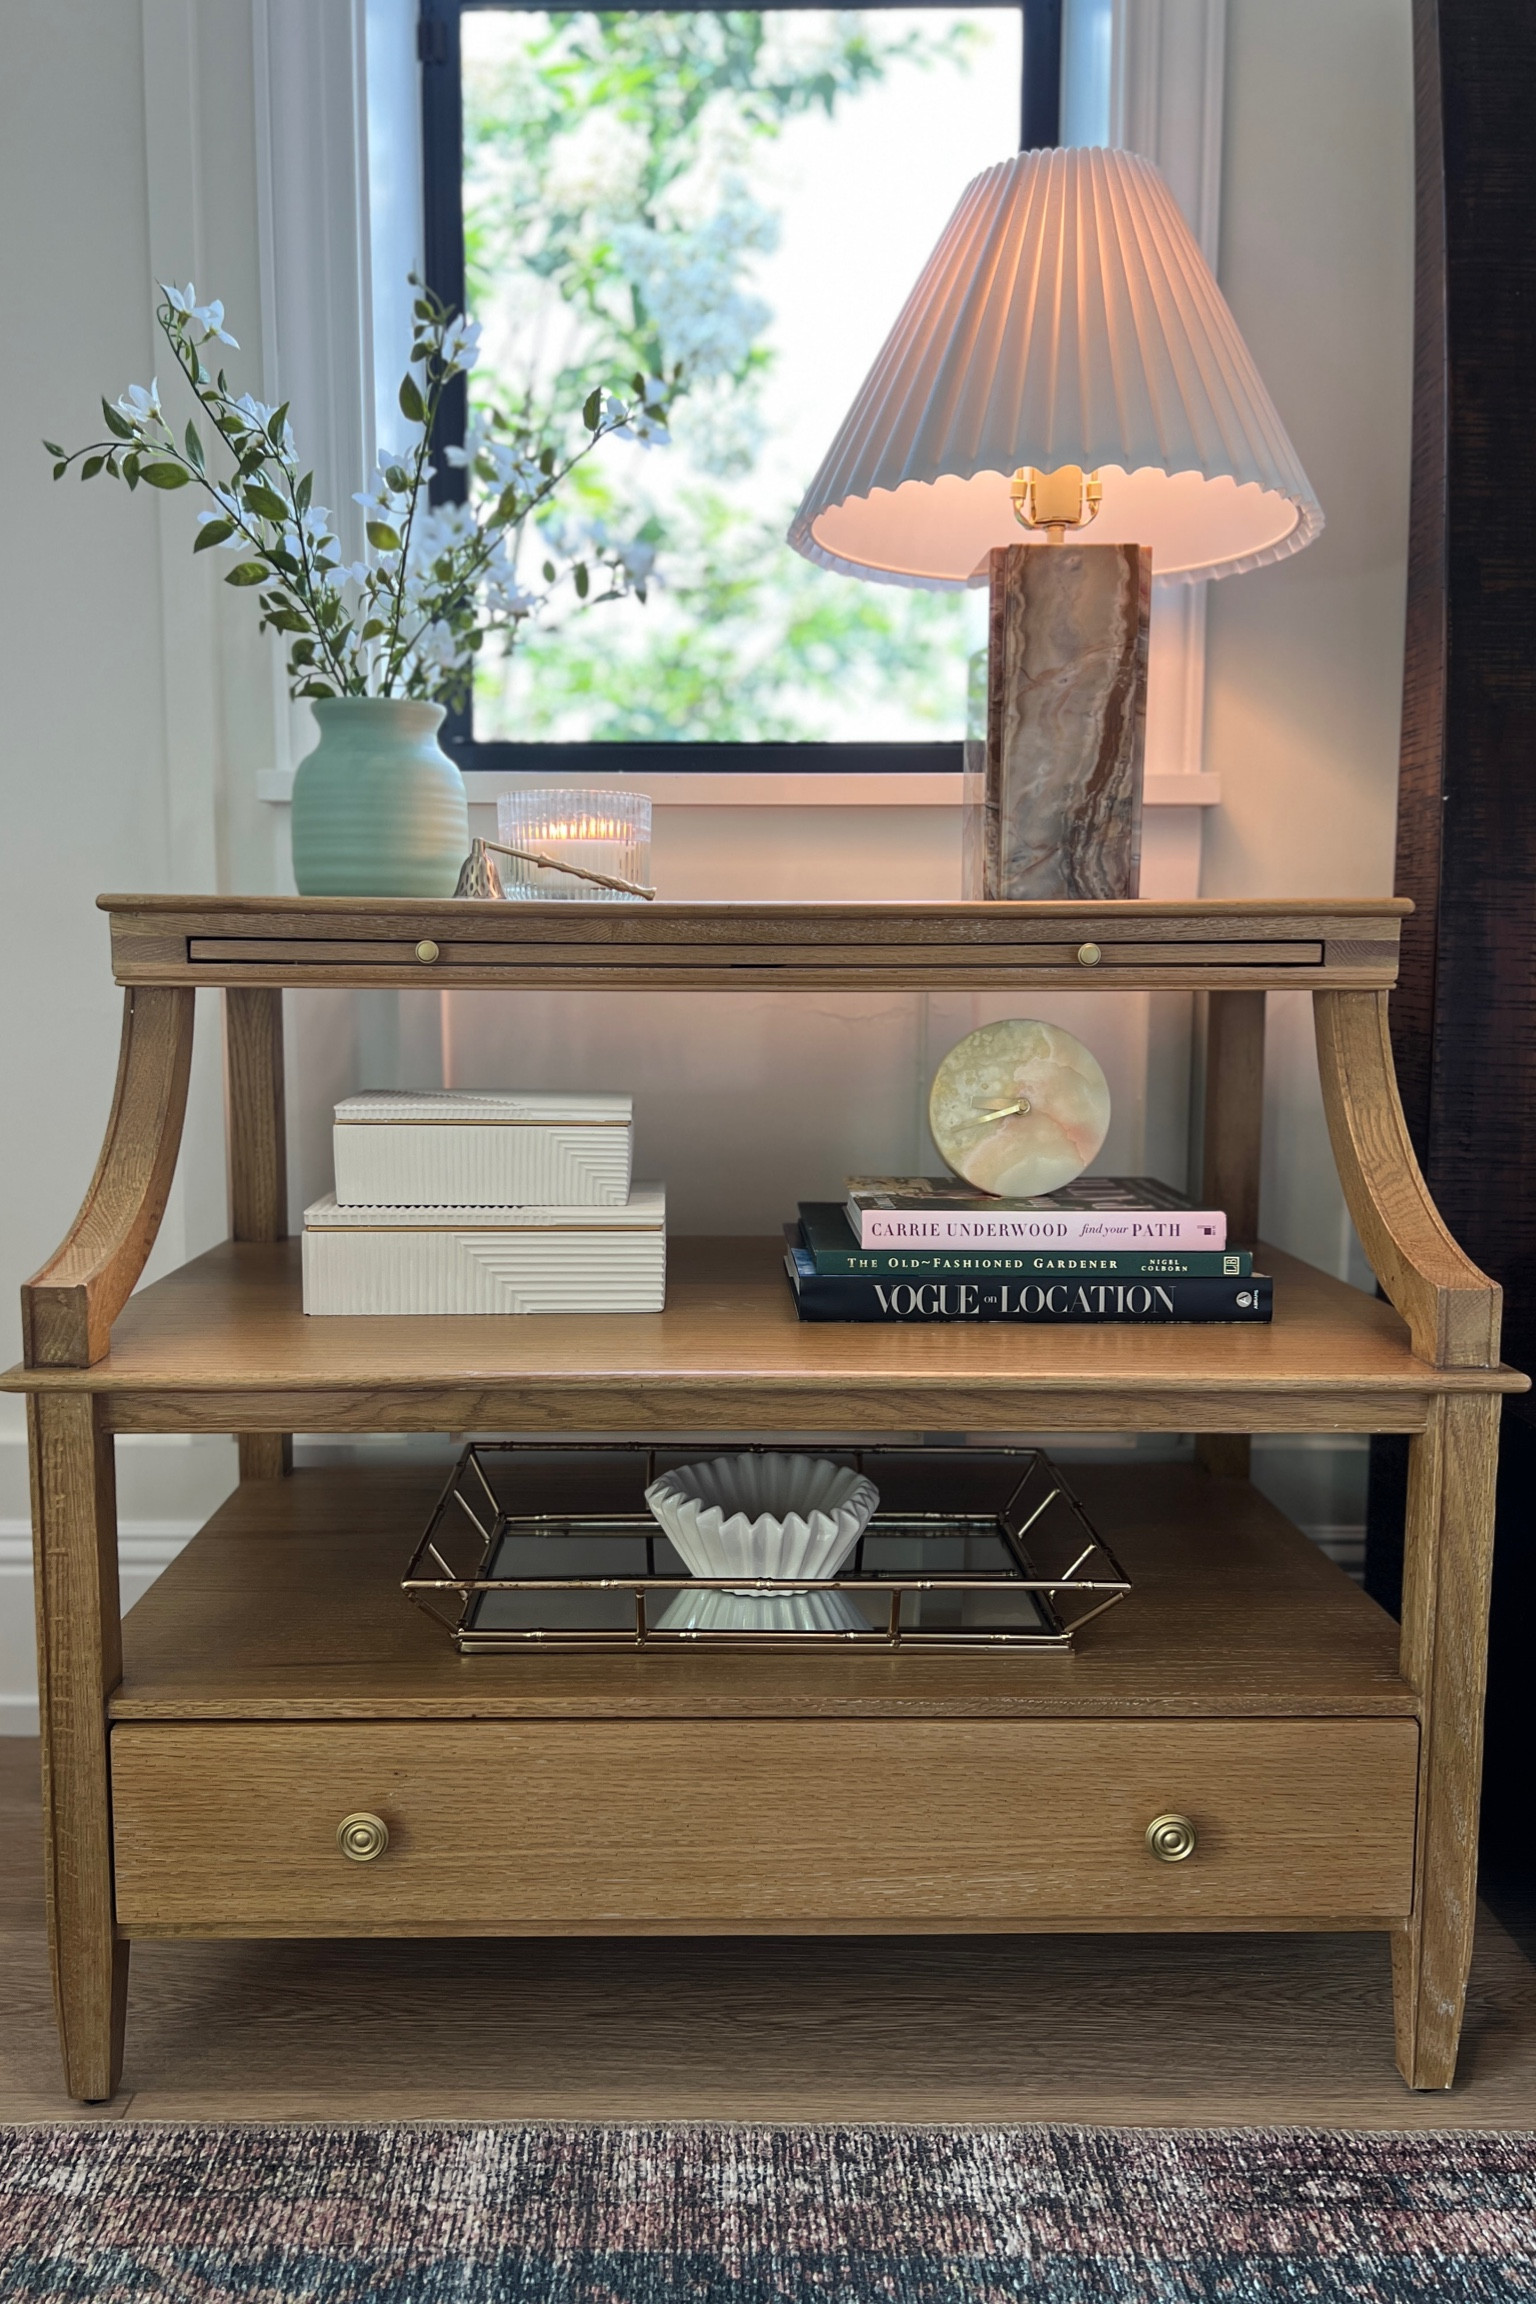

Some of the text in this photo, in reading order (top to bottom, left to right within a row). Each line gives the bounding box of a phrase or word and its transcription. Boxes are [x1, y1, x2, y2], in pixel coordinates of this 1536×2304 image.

[871, 1222, 1181, 1238] CARRIE UNDERWOOD find your PATH
[1149, 1258, 1180, 1266] NIGEL
[873, 1284, 1176, 1315] VOGUE on LOCATION
